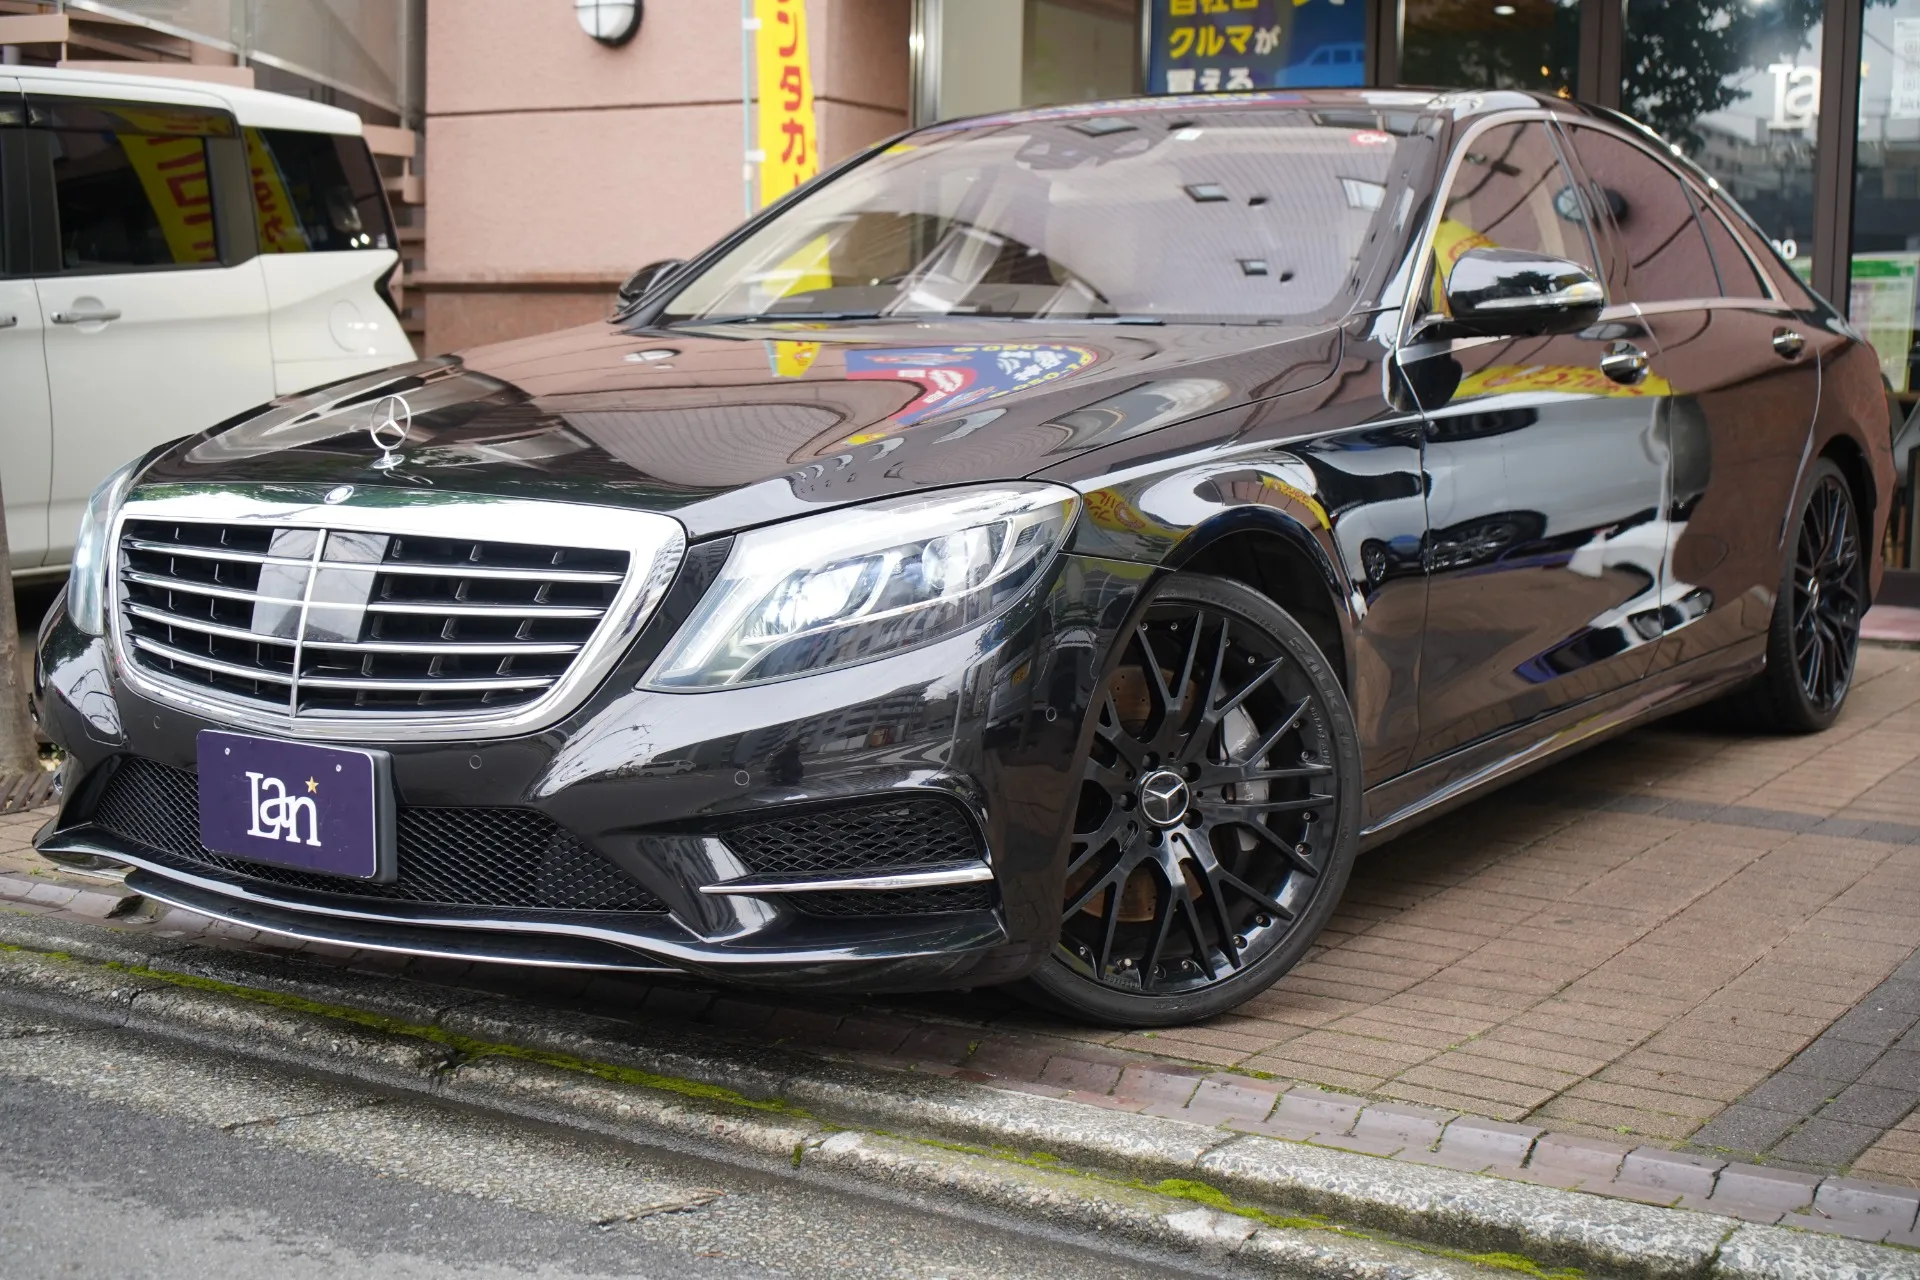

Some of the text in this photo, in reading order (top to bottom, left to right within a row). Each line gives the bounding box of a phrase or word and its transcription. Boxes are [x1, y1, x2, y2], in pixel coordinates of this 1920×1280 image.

[1168, 24, 1281, 59] クルマが
[245, 771, 322, 847] Lan
